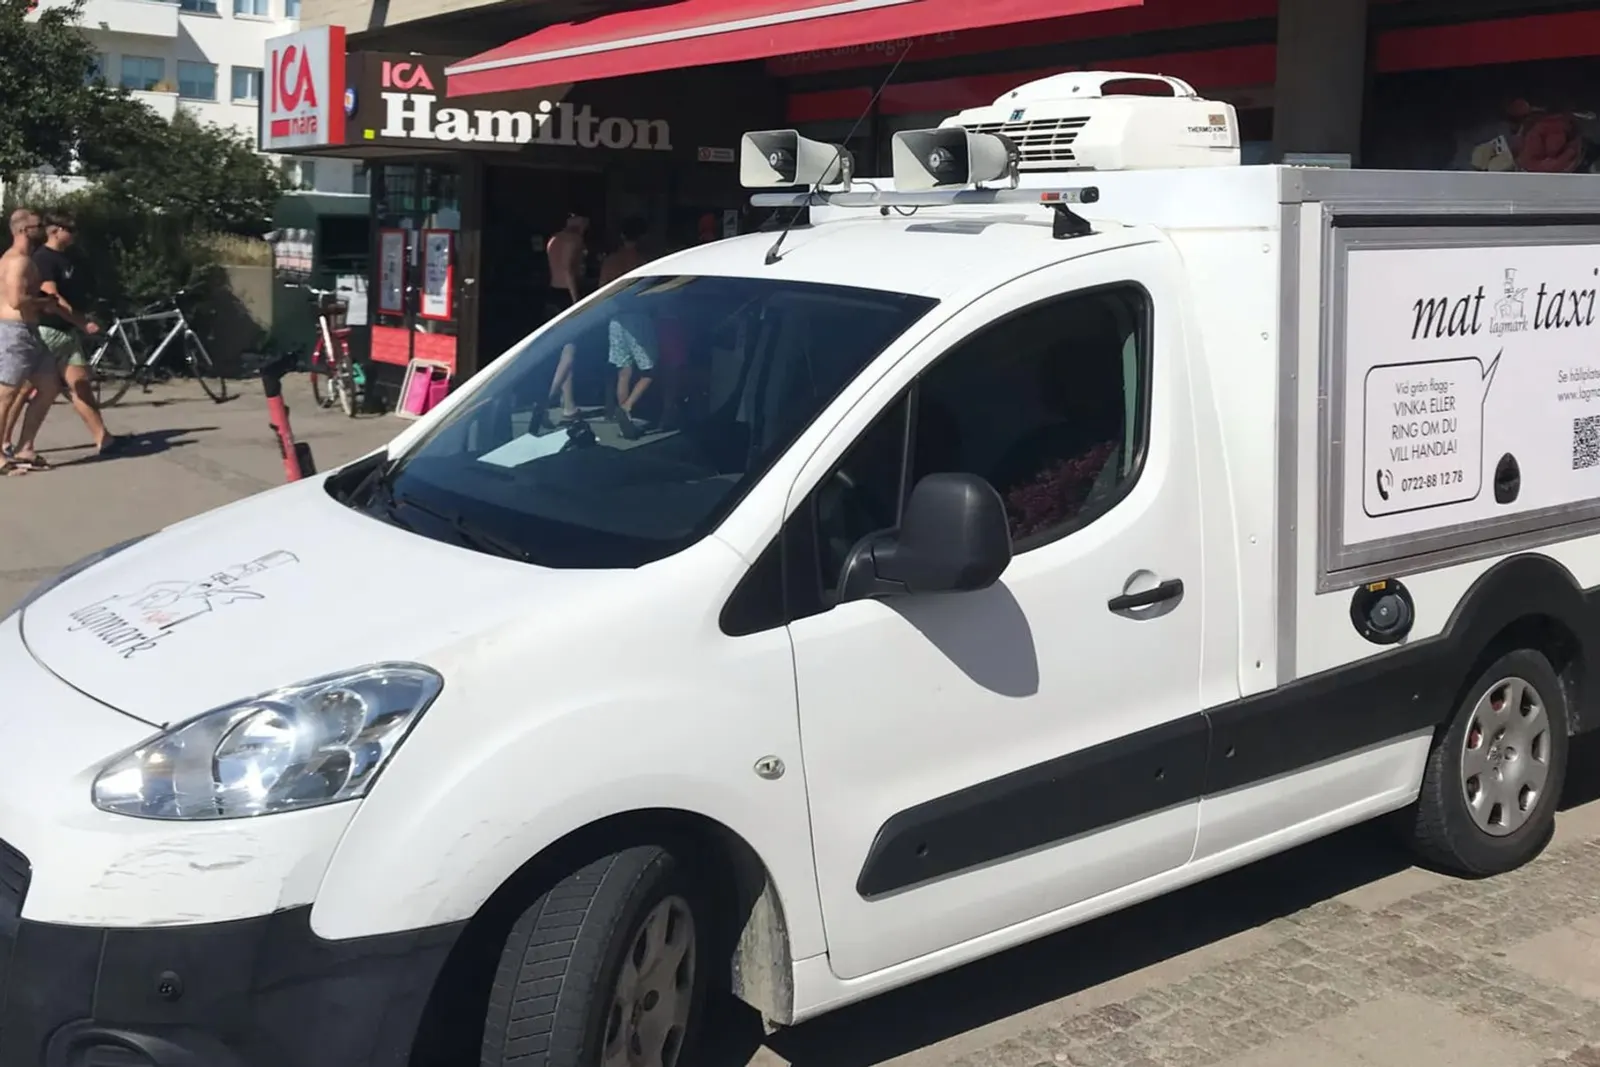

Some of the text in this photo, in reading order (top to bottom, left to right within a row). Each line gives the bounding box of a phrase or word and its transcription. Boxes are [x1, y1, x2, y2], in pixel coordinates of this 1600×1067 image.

[272, 44, 317, 113] ICA
[382, 61, 434, 90] ICA
[381, 92, 673, 150] Hamilton
[1411, 267, 1600, 340] mat taxi
[1395, 380, 1409, 395] Vid
[1411, 381, 1428, 397] grön
[1430, 377, 1448, 395] flagg
[1557, 369, 1568, 383] Se
[1393, 395, 1456, 417] VINKA ELLER
[1391, 417, 1457, 440] RING OM DU
[1389, 439, 1457, 462] VILL HANDLA!
[1401, 469, 1463, 493] 0722-88 12 78
